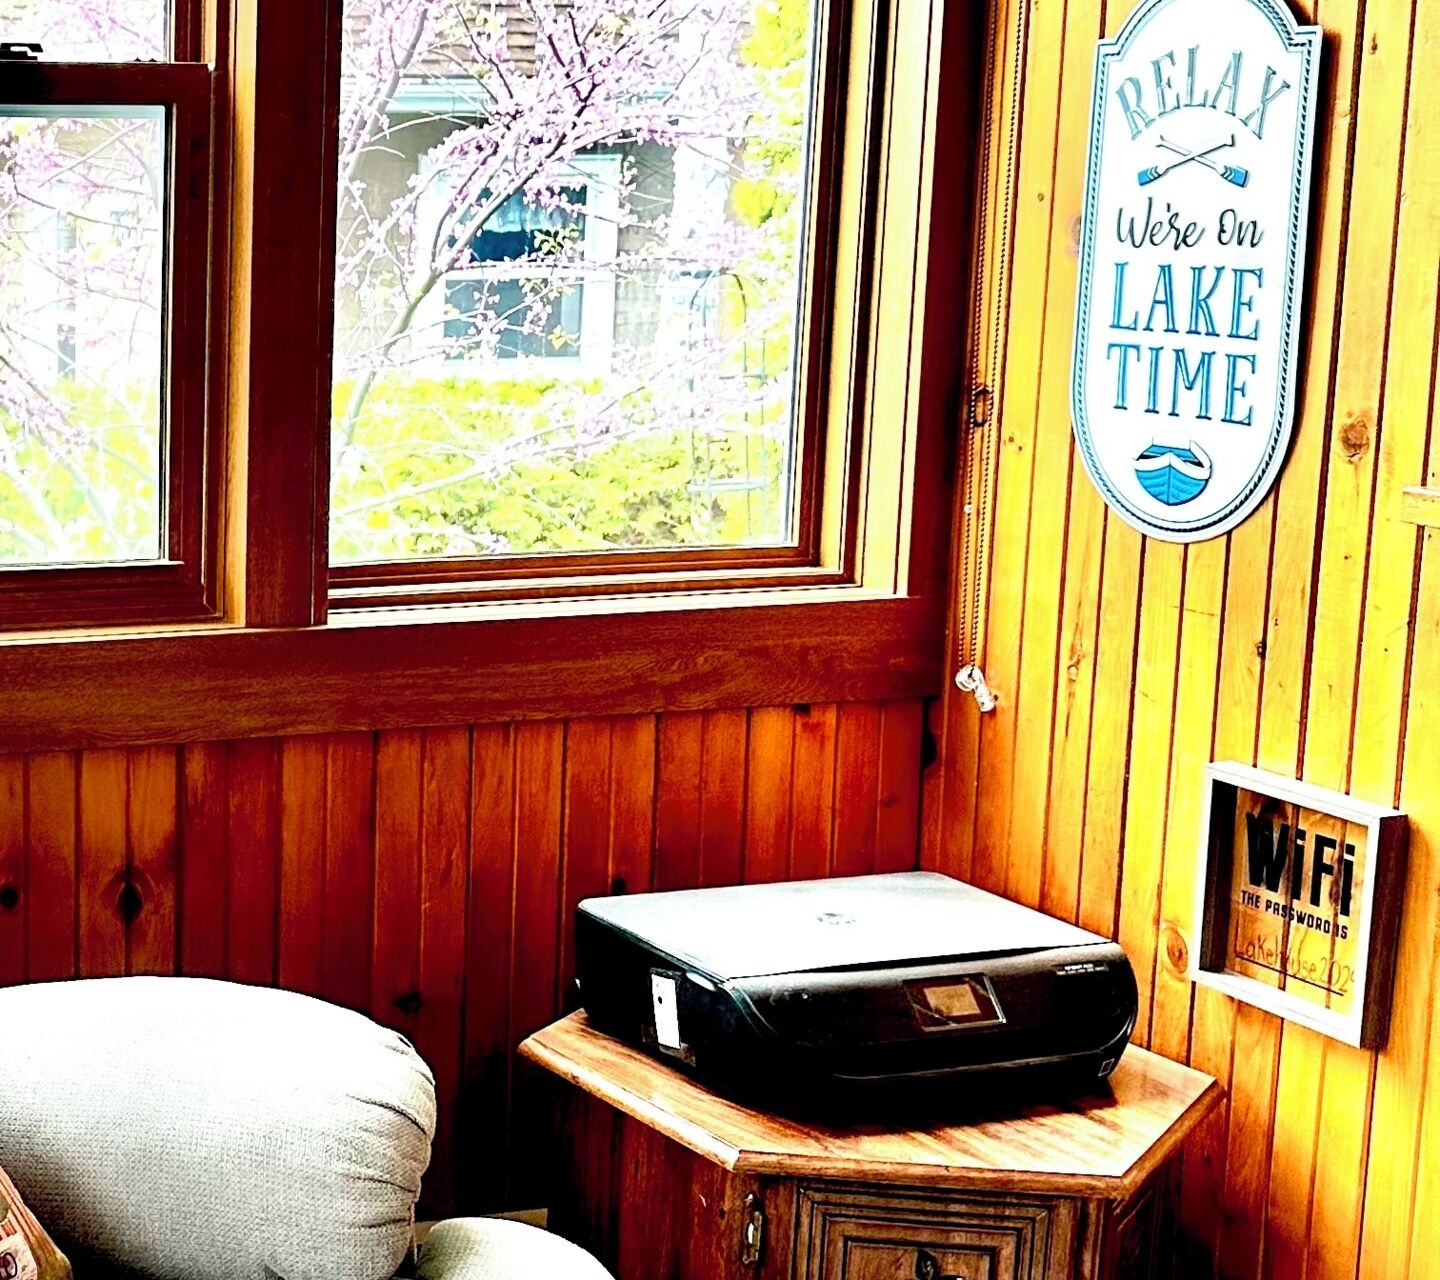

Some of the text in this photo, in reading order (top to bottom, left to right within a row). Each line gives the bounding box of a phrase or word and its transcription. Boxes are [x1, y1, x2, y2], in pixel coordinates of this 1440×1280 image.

[1116, 44, 1290, 140] RELAX
[1116, 197, 1264, 250] We're On
[1109, 262, 1263, 340] LAKE
[1107, 343, 1256, 426] TIME
[1246, 812, 1355, 917] WiFi
[1241, 889, 1261, 909] THE
[1265, 899, 1331, 934] PASSWORD
